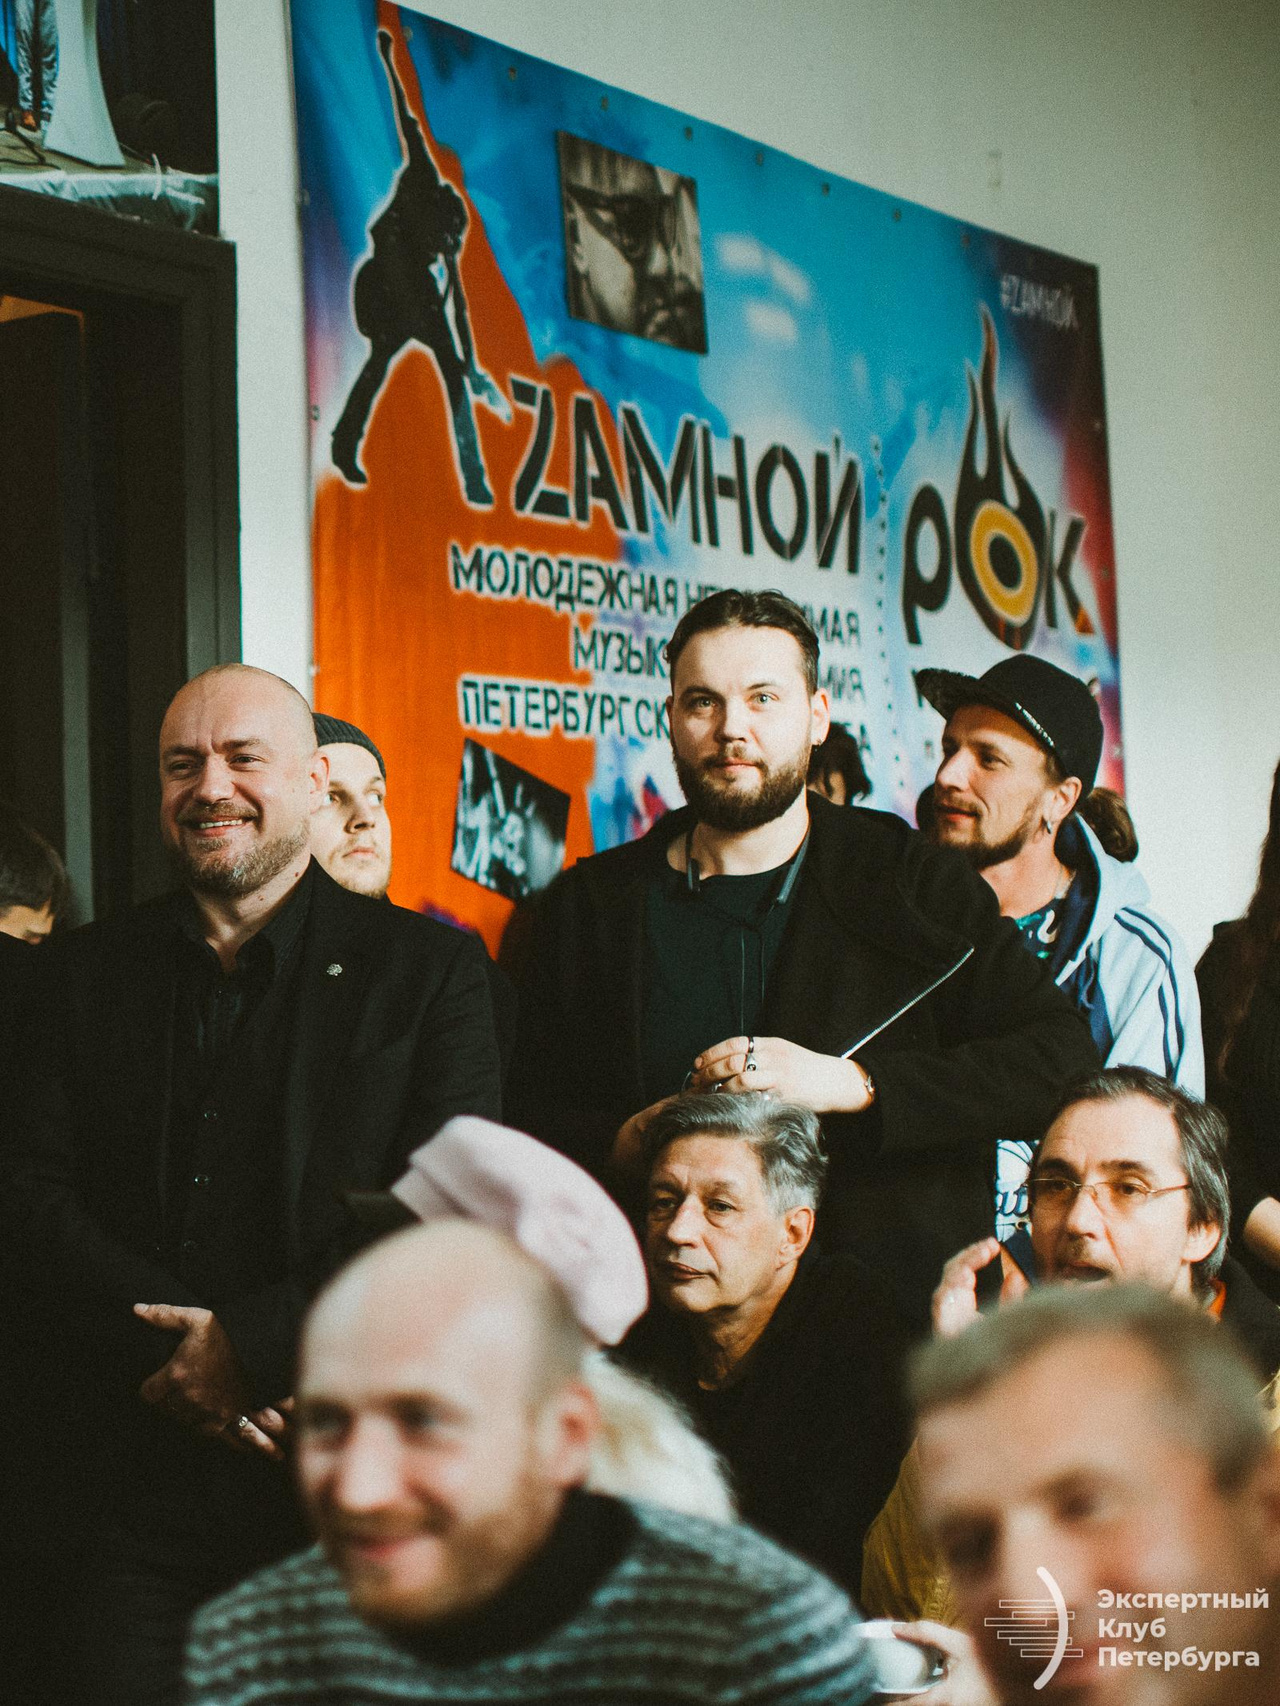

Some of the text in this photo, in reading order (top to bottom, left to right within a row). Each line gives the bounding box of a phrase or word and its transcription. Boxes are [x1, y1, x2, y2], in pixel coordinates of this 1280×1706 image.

[451, 544, 678, 616] МОЛОДЕЖНАЯ
[574, 625, 668, 679] МУЗЫК
[461, 679, 671, 740] ПЕТЕРБУРГСК
